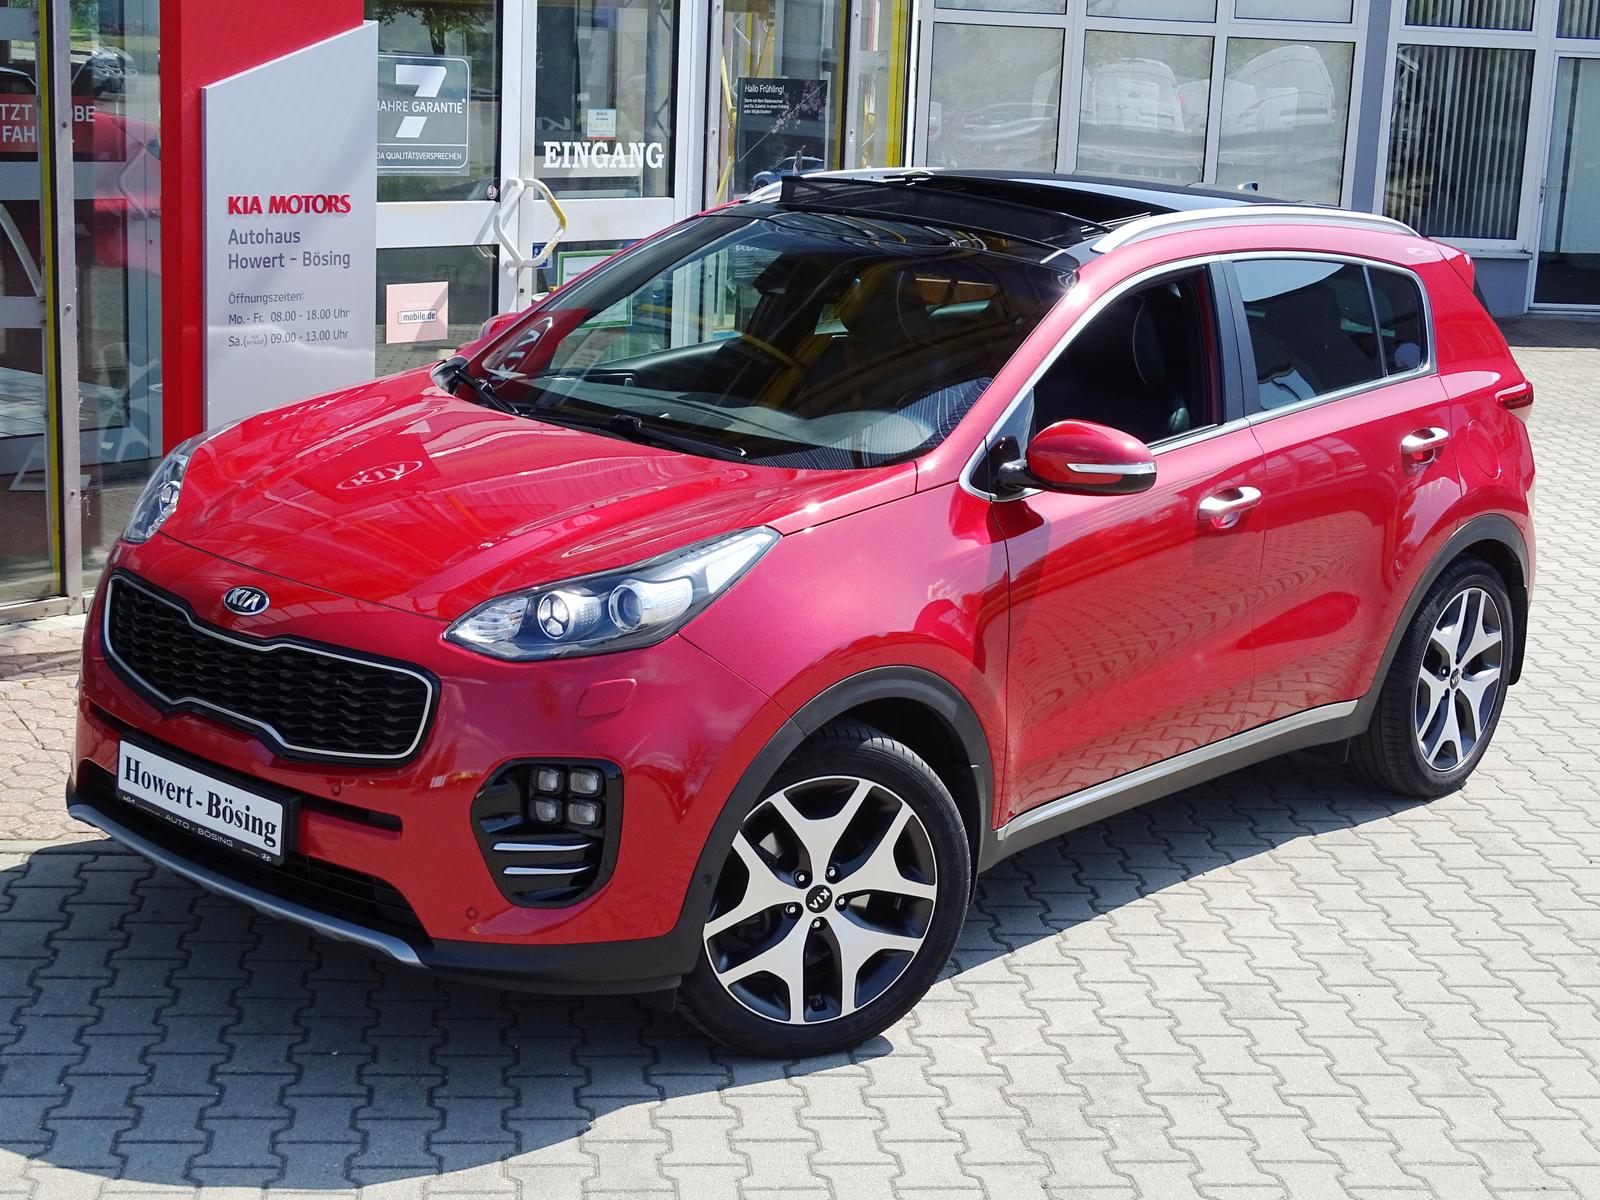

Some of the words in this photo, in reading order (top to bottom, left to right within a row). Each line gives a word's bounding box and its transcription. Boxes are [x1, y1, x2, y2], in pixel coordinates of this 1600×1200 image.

[744, 84, 759, 93] Hallo
[759, 84, 785, 96] Frühling!
[386, 151, 462, 160] QUALITÄTSVERSPRECHEN
[542, 141, 665, 169] EINGANG
[227, 195, 263, 215] KIA
[268, 194, 352, 214] MOTORS
[228, 228, 301, 245] Autohaus
[228, 253, 285, 270] Howert
[302, 251, 351, 269] Bösing
[228, 291, 304, 305] Öffnungszeiten:
[270, 311, 296, 323] 08.00
[306, 308, 331, 320] 18.00
[333, 307, 349, 319] Uhr
[270, 332, 296, 344] 09.00
[306, 330, 331, 342] 13.00
[333, 328, 349, 340] Uhr
[227, 588, 261, 611] KIA
[165, 814, 190, 829] AUTO
[808, 888, 831, 909] KIA
